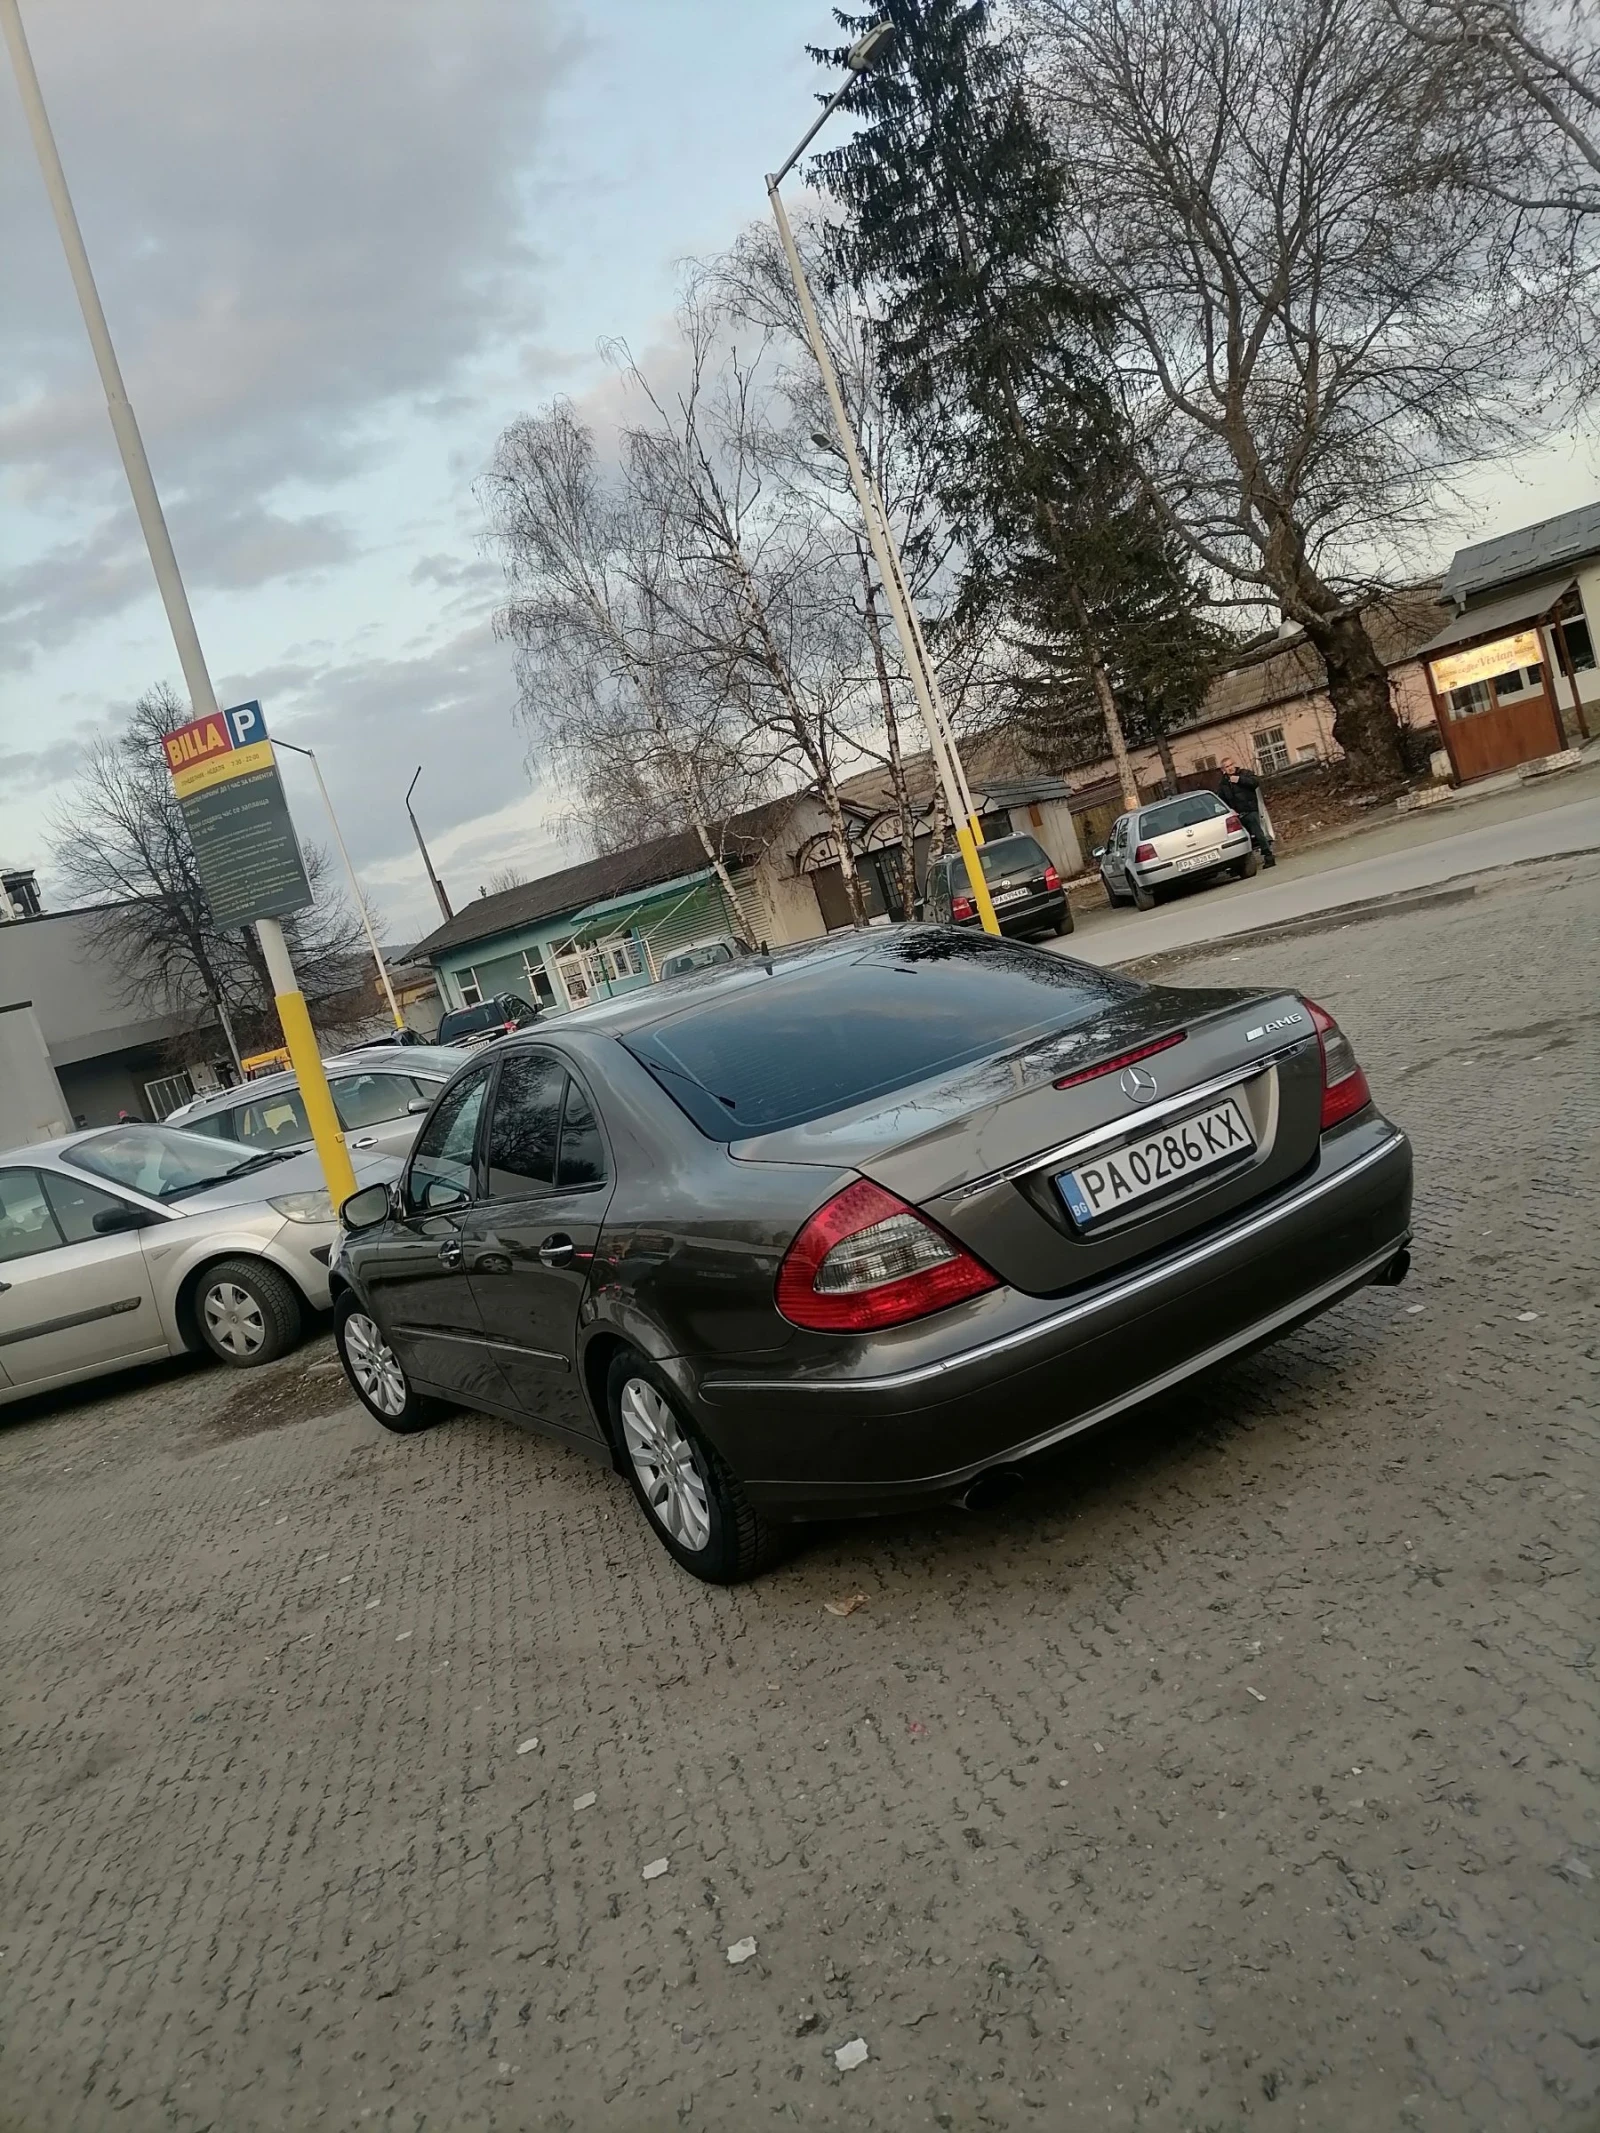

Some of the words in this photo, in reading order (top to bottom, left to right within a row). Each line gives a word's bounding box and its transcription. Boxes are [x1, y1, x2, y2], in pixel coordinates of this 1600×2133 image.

[232, 708, 255, 743] P
[167, 723, 225, 767] BILLA
[1265, 1012, 1302, 1033] AMG
[1081, 1161, 1132, 1208] PA
[1129, 1128, 1203, 1186] 0286
[1197, 1109, 1244, 1154] KX
[1071, 1202, 1088, 1217] BG
